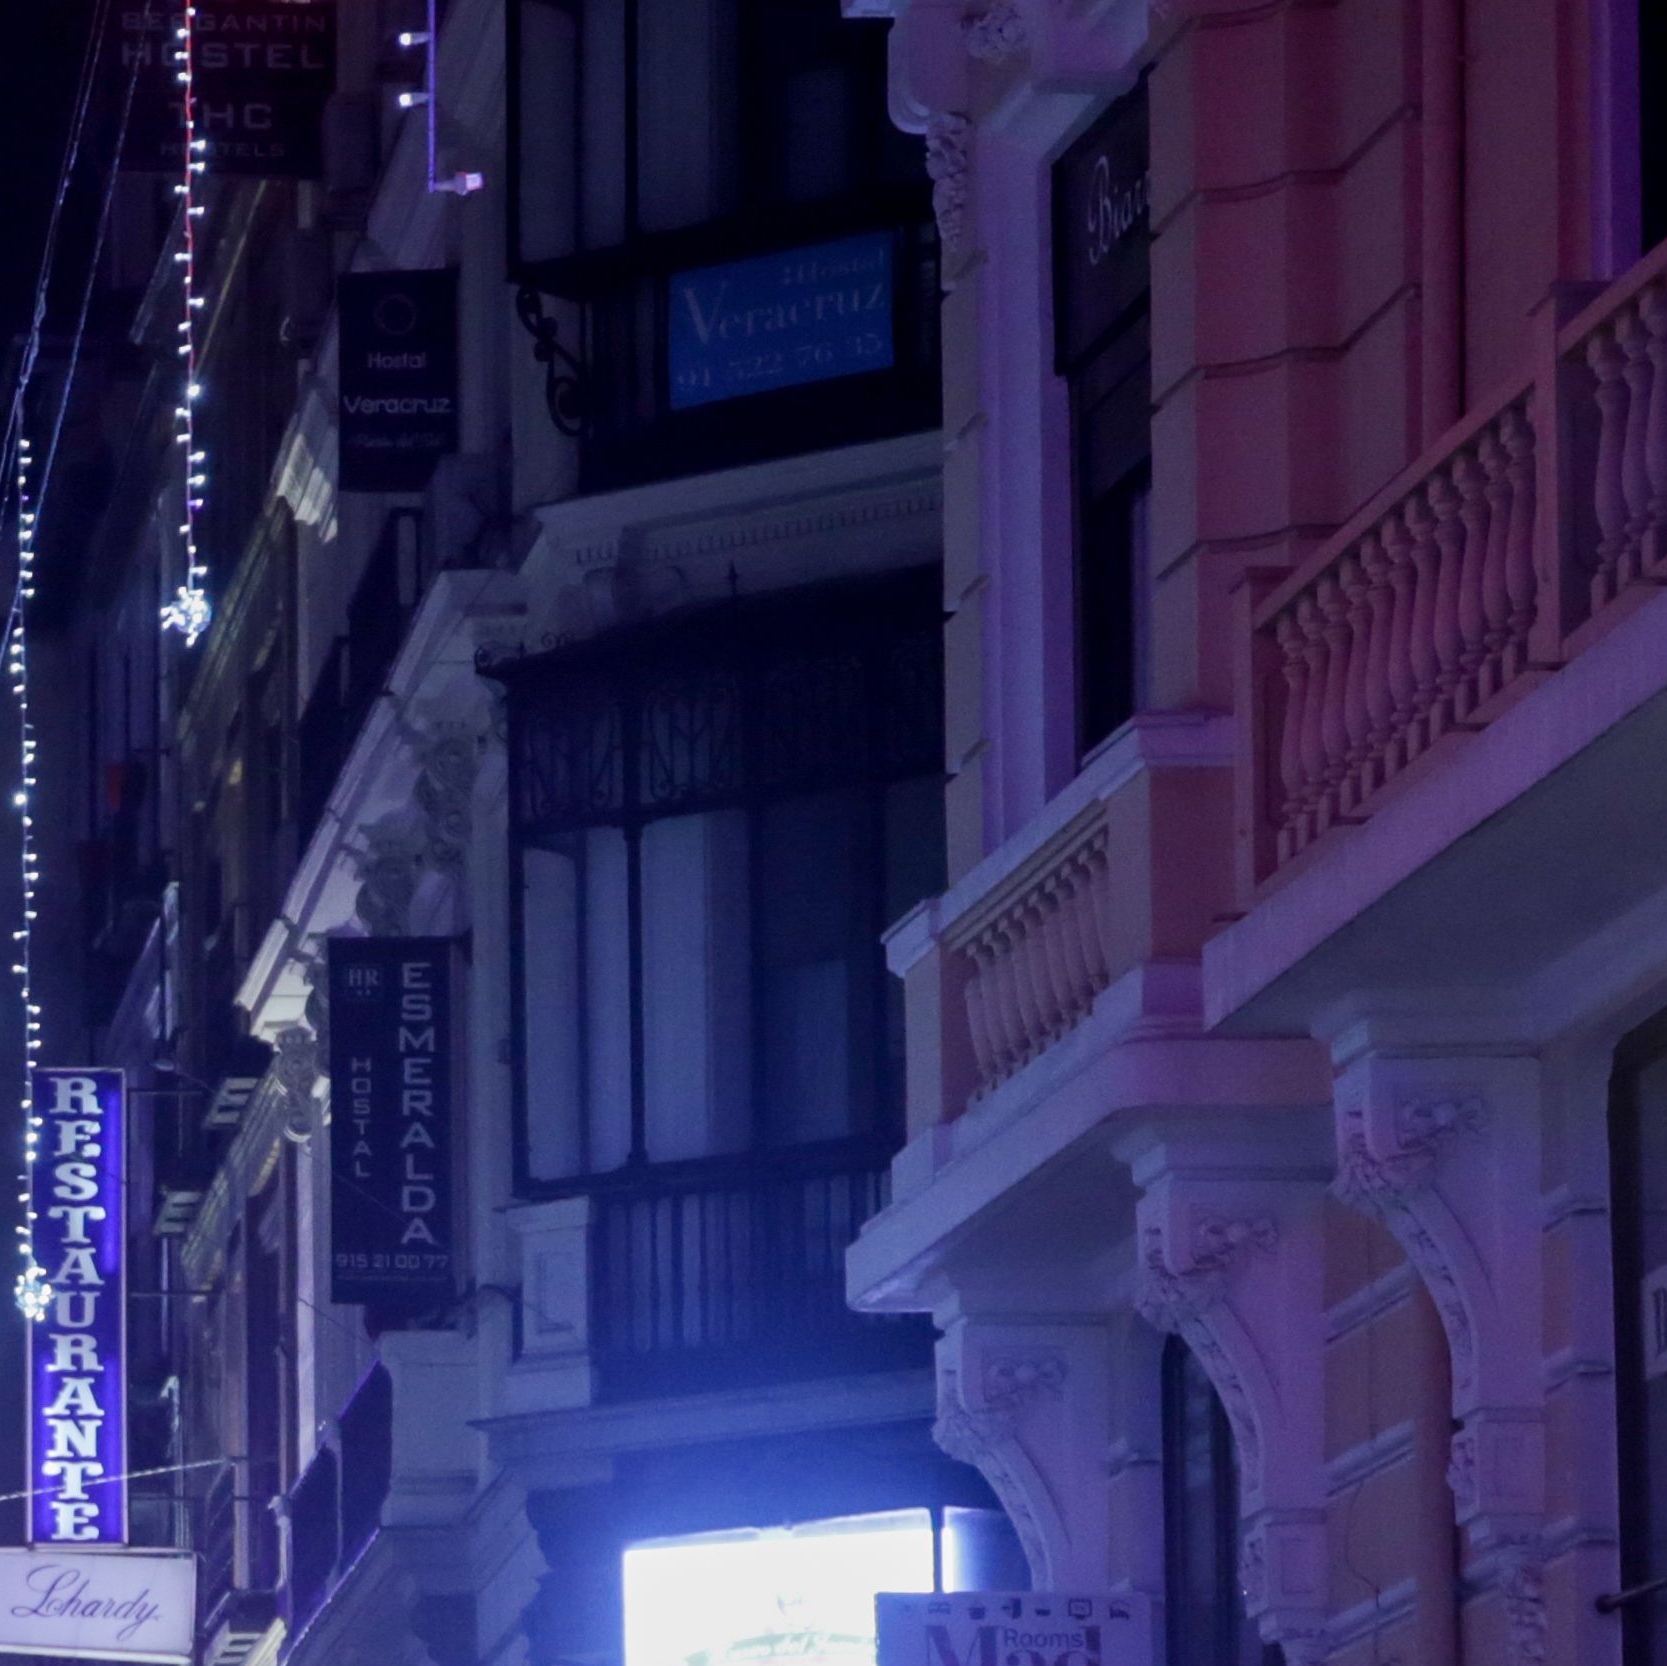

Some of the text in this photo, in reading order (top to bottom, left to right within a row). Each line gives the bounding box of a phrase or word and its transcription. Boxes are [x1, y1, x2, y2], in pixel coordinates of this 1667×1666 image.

[122, 41, 326, 70] HOSTEL
[169, 101, 273, 129] THC
[682, 280, 886, 346] Veracruz
[368, 351, 427, 369] Hostal
[343, 395, 453, 414] Veracruz
[348, 967, 379, 988] HR
[351, 1056, 373, 1178] HOSTAL
[398, 962, 438, 1246] ESMERALDA
[41, 1076, 106, 1542] RESTAURANTE
[10, 1564, 163, 1642] Lhardy
[1004, 1628, 1084, 1649] Rooms
